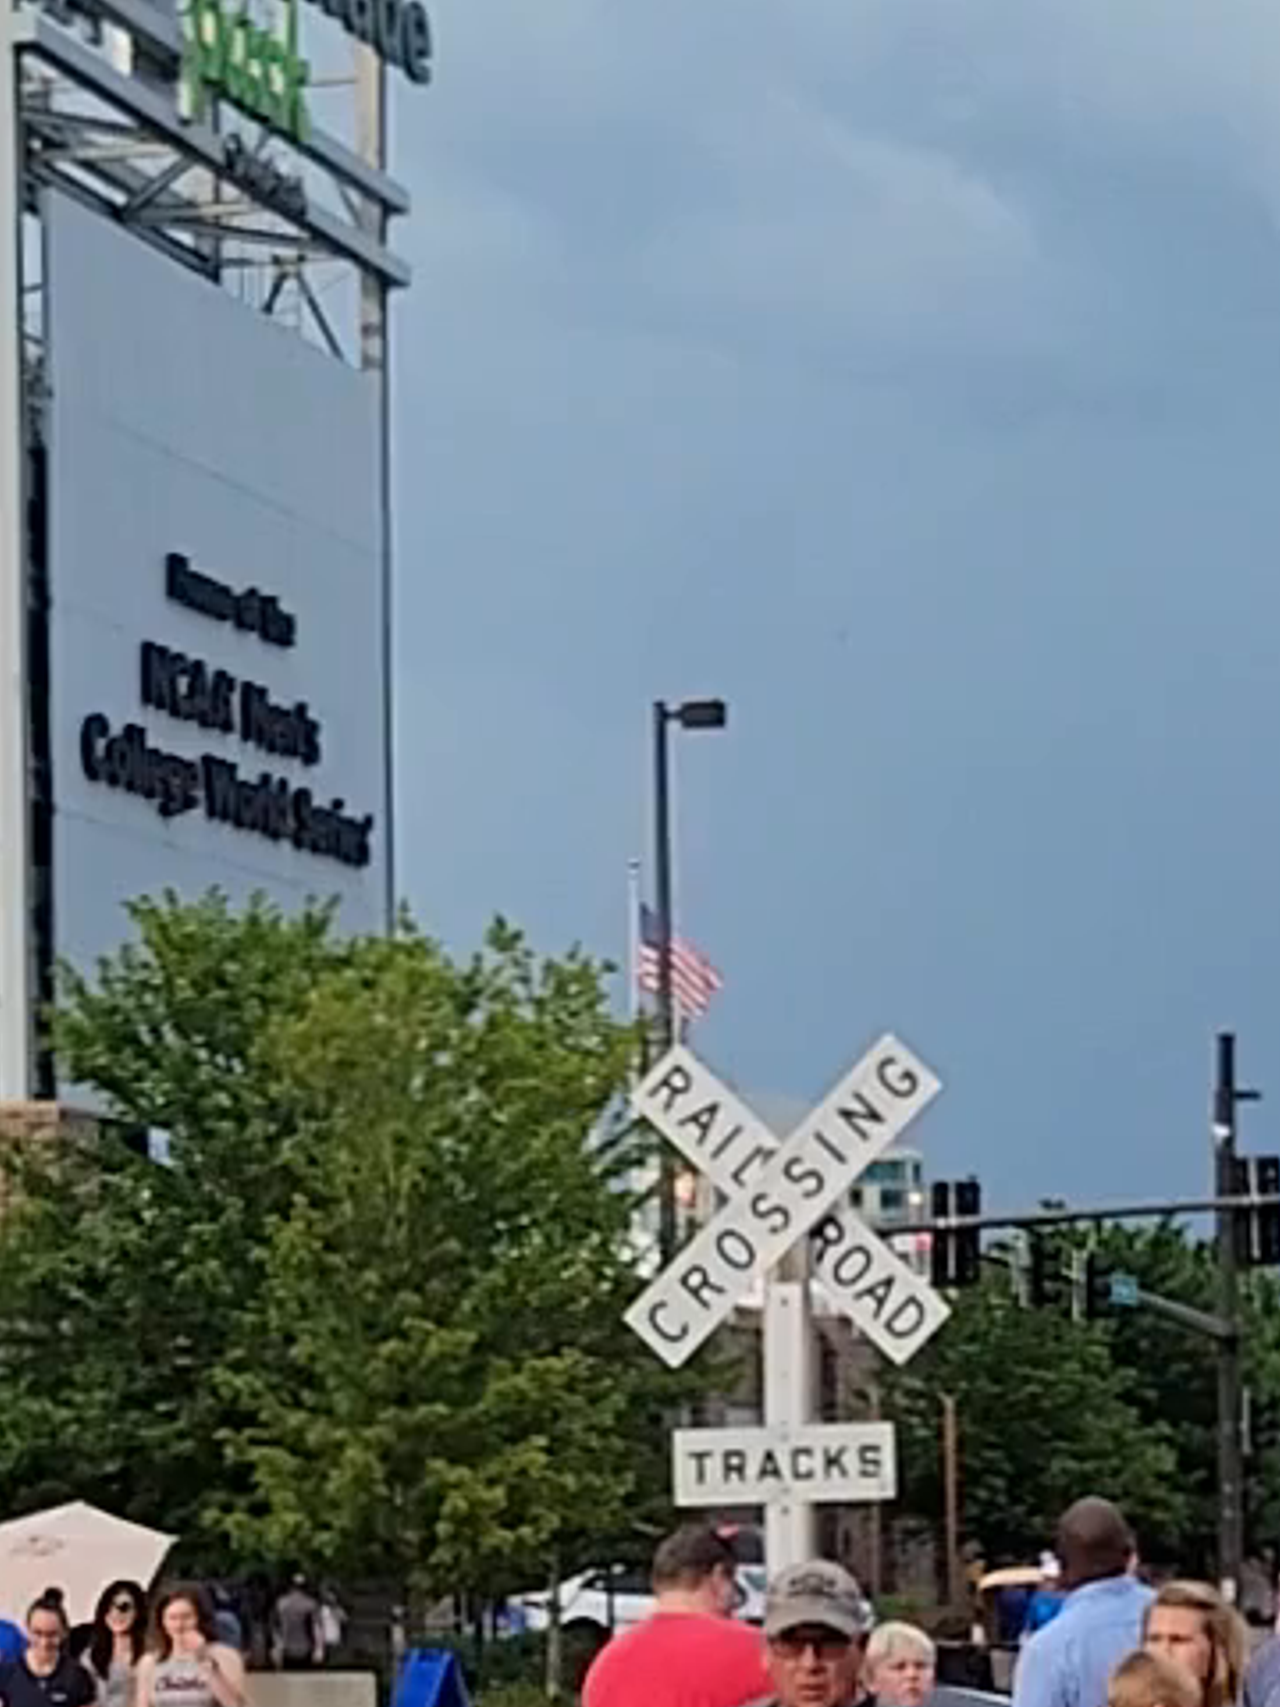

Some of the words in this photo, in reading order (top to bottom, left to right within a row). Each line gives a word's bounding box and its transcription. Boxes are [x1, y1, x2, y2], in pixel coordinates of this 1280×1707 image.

[80, 712, 200, 818] College
[201, 752, 291, 843] World
[648, 1054, 921, 1345] CROSSING
[648, 1064, 764, 1190] RAIL
[811, 1213, 927, 1340] ROAD
[688, 1443, 884, 1484] TRACKS
